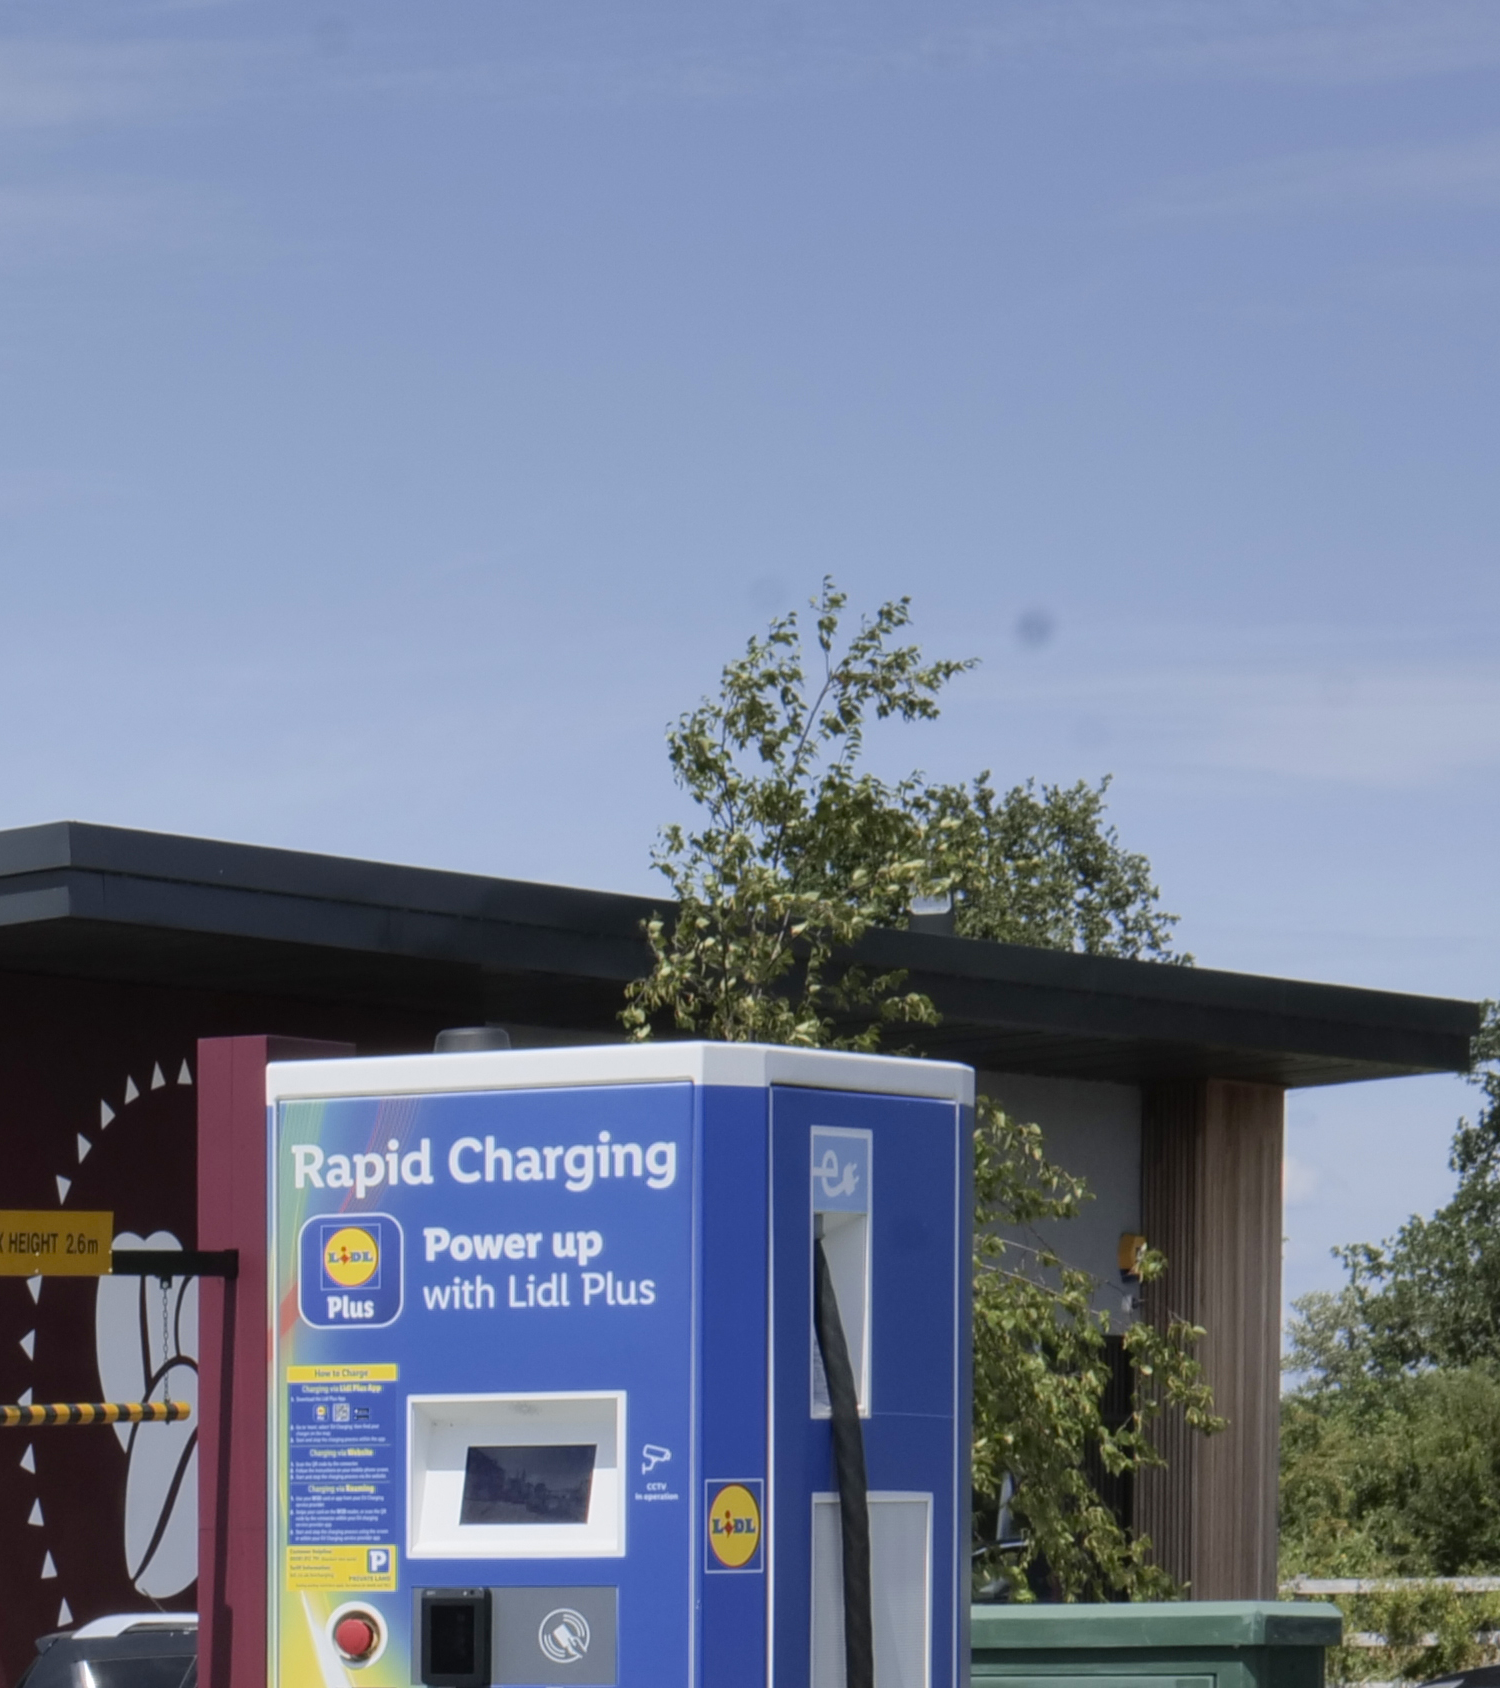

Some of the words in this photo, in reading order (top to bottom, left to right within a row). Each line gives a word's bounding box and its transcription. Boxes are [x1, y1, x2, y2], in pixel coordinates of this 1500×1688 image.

[291, 1138, 434, 1198] Rapid
[448, 1131, 677, 1192] Charging
[8, 1232, 59, 1254] HEIGHT
[66, 1233, 99, 1255] 2.6m
[423, 1227, 542, 1262] Power
[552, 1230, 603, 1266] up
[423, 1275, 495, 1310] with
[508, 1273, 570, 1309] Lidl
[581, 1271, 656, 1306] Plus
[327, 1295, 375, 1320] Plus
[314, 1369, 331, 1378] How
[332, 1369, 340, 1377] to
[342, 1368, 368, 1379] Charge
[644, 1492, 679, 1502] operation
[646, 1482, 667, 1491] CCTV
